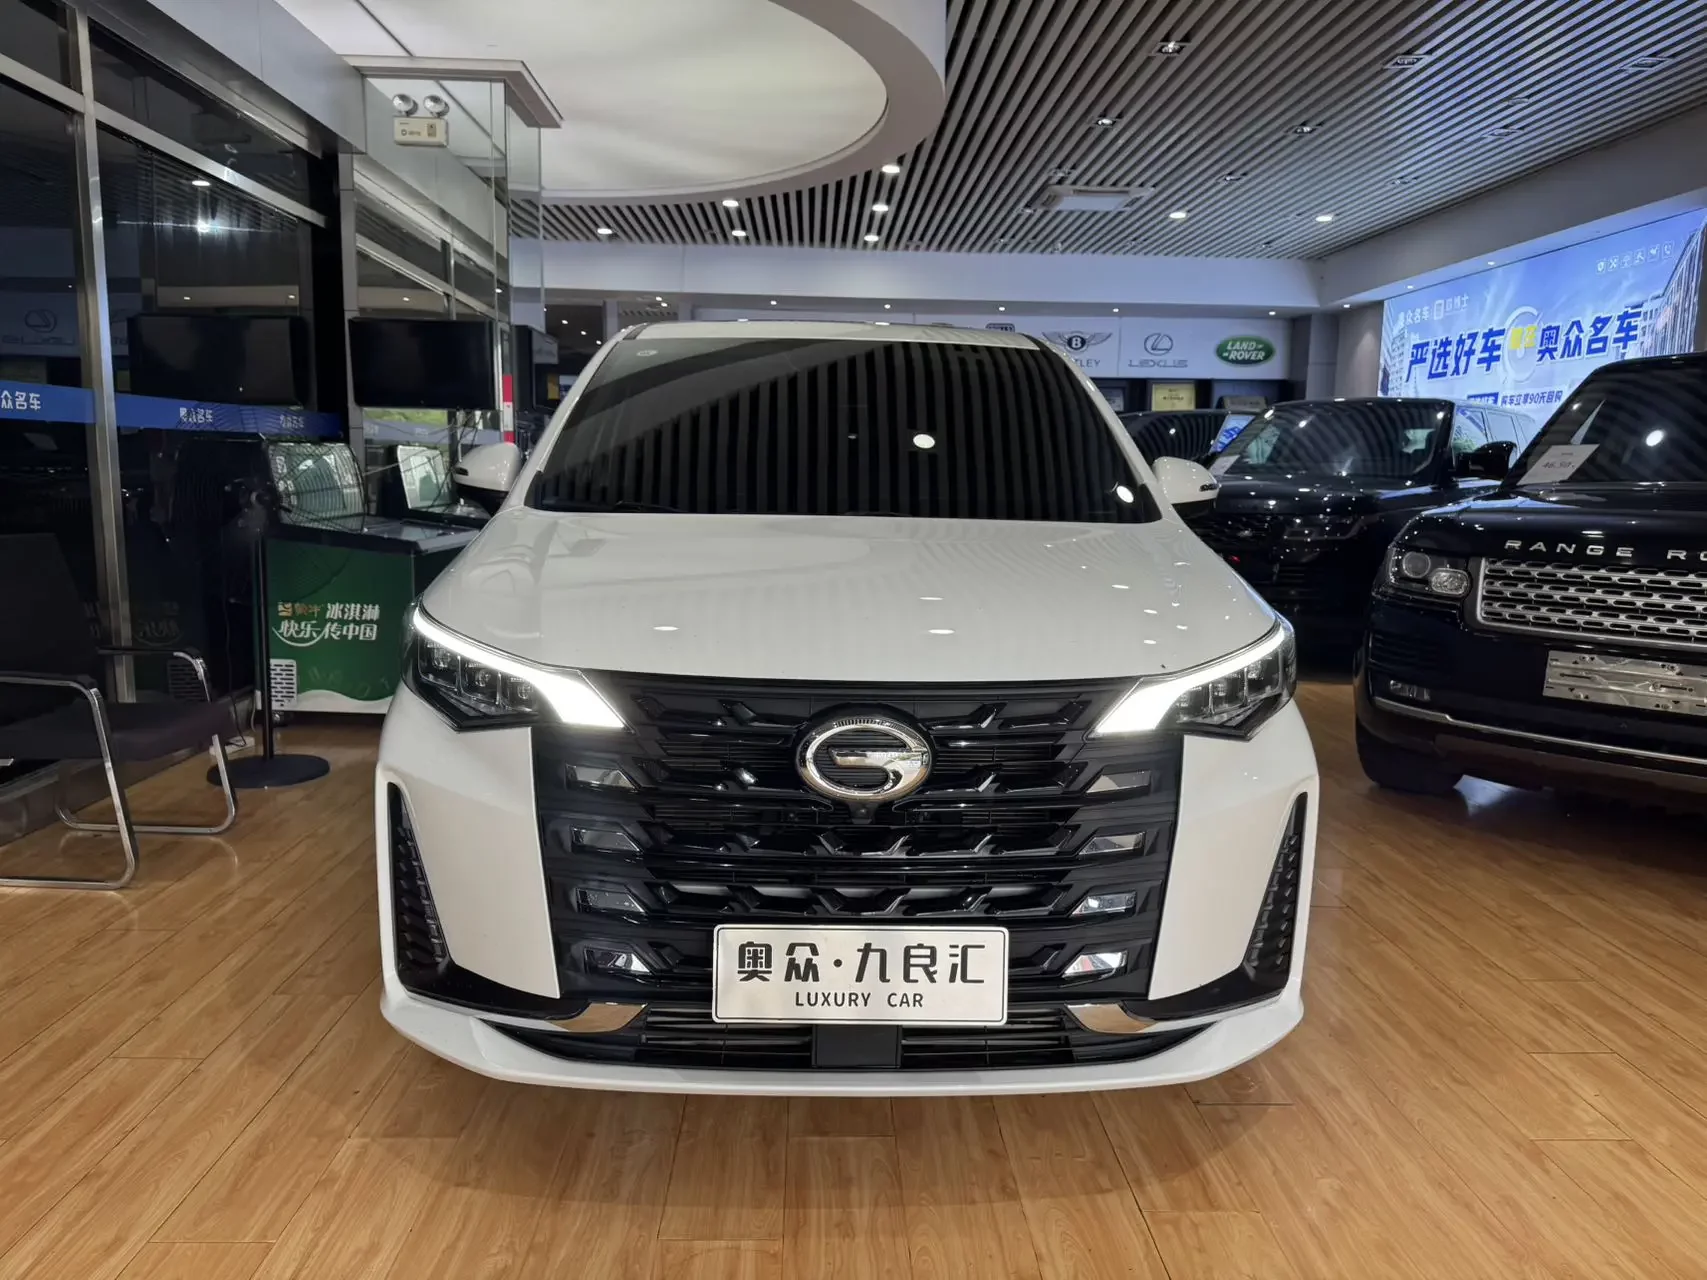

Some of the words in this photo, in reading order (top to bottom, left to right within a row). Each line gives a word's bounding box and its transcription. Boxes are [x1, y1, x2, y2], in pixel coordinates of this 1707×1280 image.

[1226, 341, 1256, 351] LAND
[1406, 327, 1505, 383] 严选好车
[1537, 304, 1643, 362] 奥众名车
[1128, 359, 1188, 368] LEXUS
[1228, 350, 1266, 362] ROVER
[1504, 540, 1634, 558] RANGE
[326, 602, 380, 620] 冰淇淋
[795, 992, 871, 1008] LUXURY
[887, 993, 924, 1008] CAR
